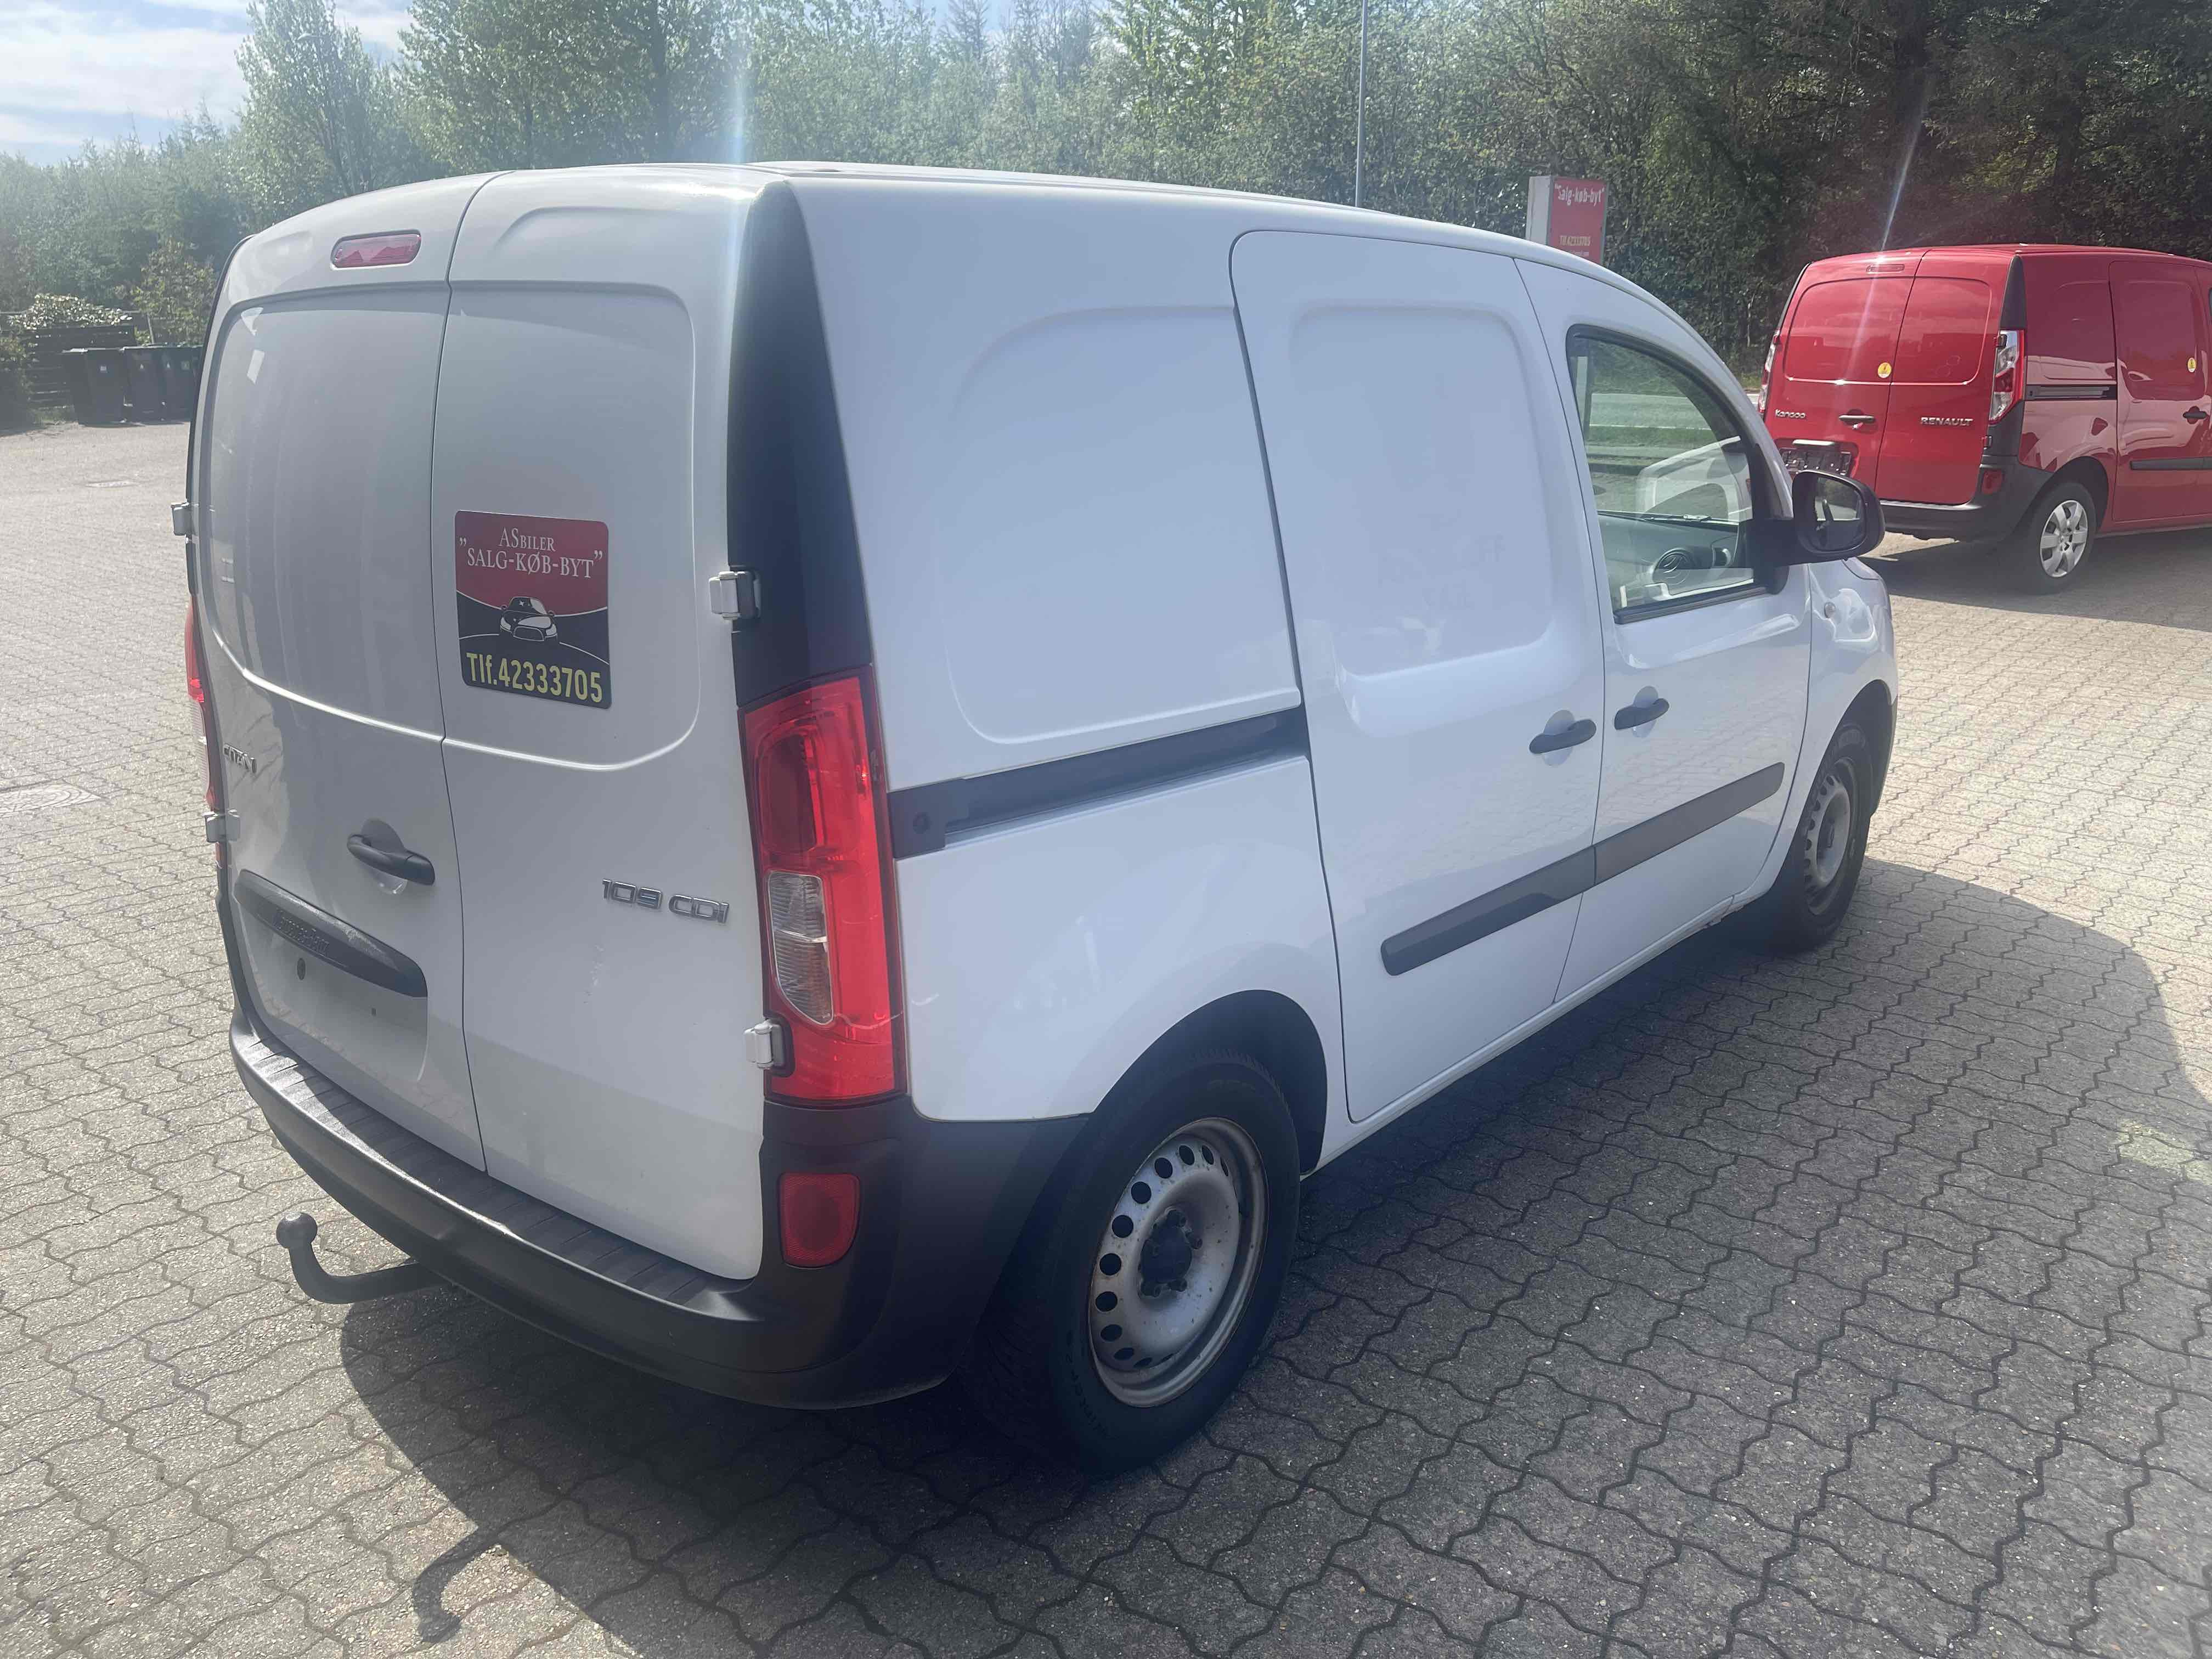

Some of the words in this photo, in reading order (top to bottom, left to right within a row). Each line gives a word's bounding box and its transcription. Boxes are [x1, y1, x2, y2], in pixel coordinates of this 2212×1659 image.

[1921, 417, 1973, 426] RENAULT
[602, 878, 663, 909] 109
[669, 894, 729, 923] CDI
